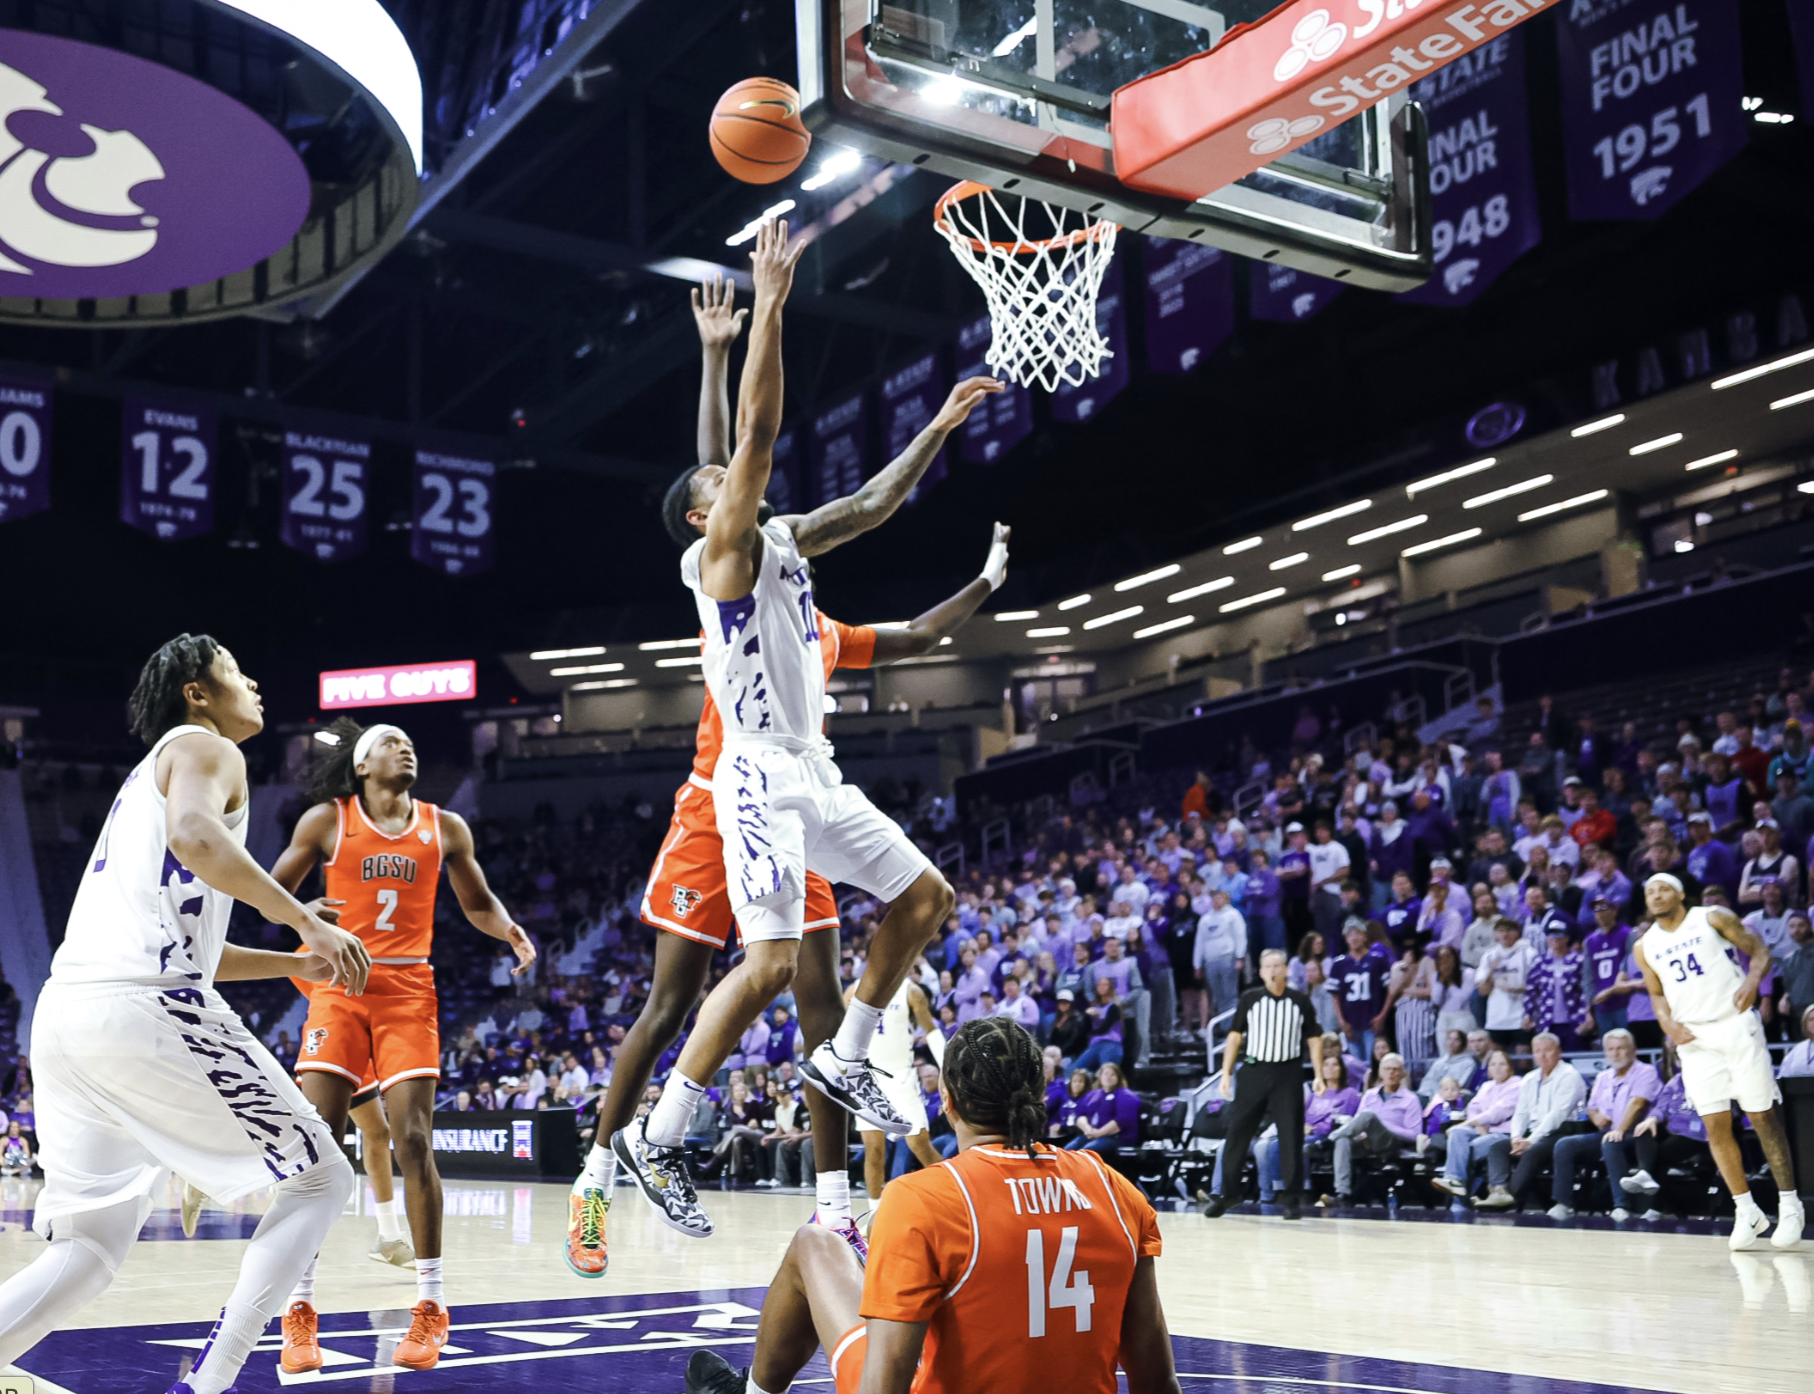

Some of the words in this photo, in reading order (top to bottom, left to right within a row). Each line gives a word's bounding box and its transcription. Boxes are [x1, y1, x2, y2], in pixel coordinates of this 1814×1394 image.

[1590, 4, 1698, 78] FINAL
[1592, 36, 1697, 112] FOUR
[1427, 109, 1498, 165] INAL
[1593, 92, 1711, 179] 1951
[1430, 140, 1498, 194] OUR
[1432, 194, 1510, 264] 948
[131, 431, 208, 499] 12
[290, 455, 364, 521] 25
[420, 473, 490, 537] 23
[323, 674, 386, 703] FIVE
[390, 667, 470, 697] GUYS
[361, 853, 417, 885] BGSU
[375, 889, 398, 932] 2
[1344, 971, 1372, 1002] 31
[1598, 959, 1613, 980] 0
[1669, 953, 1704, 983] 34
[1025, 1226, 1095, 1338] 14
